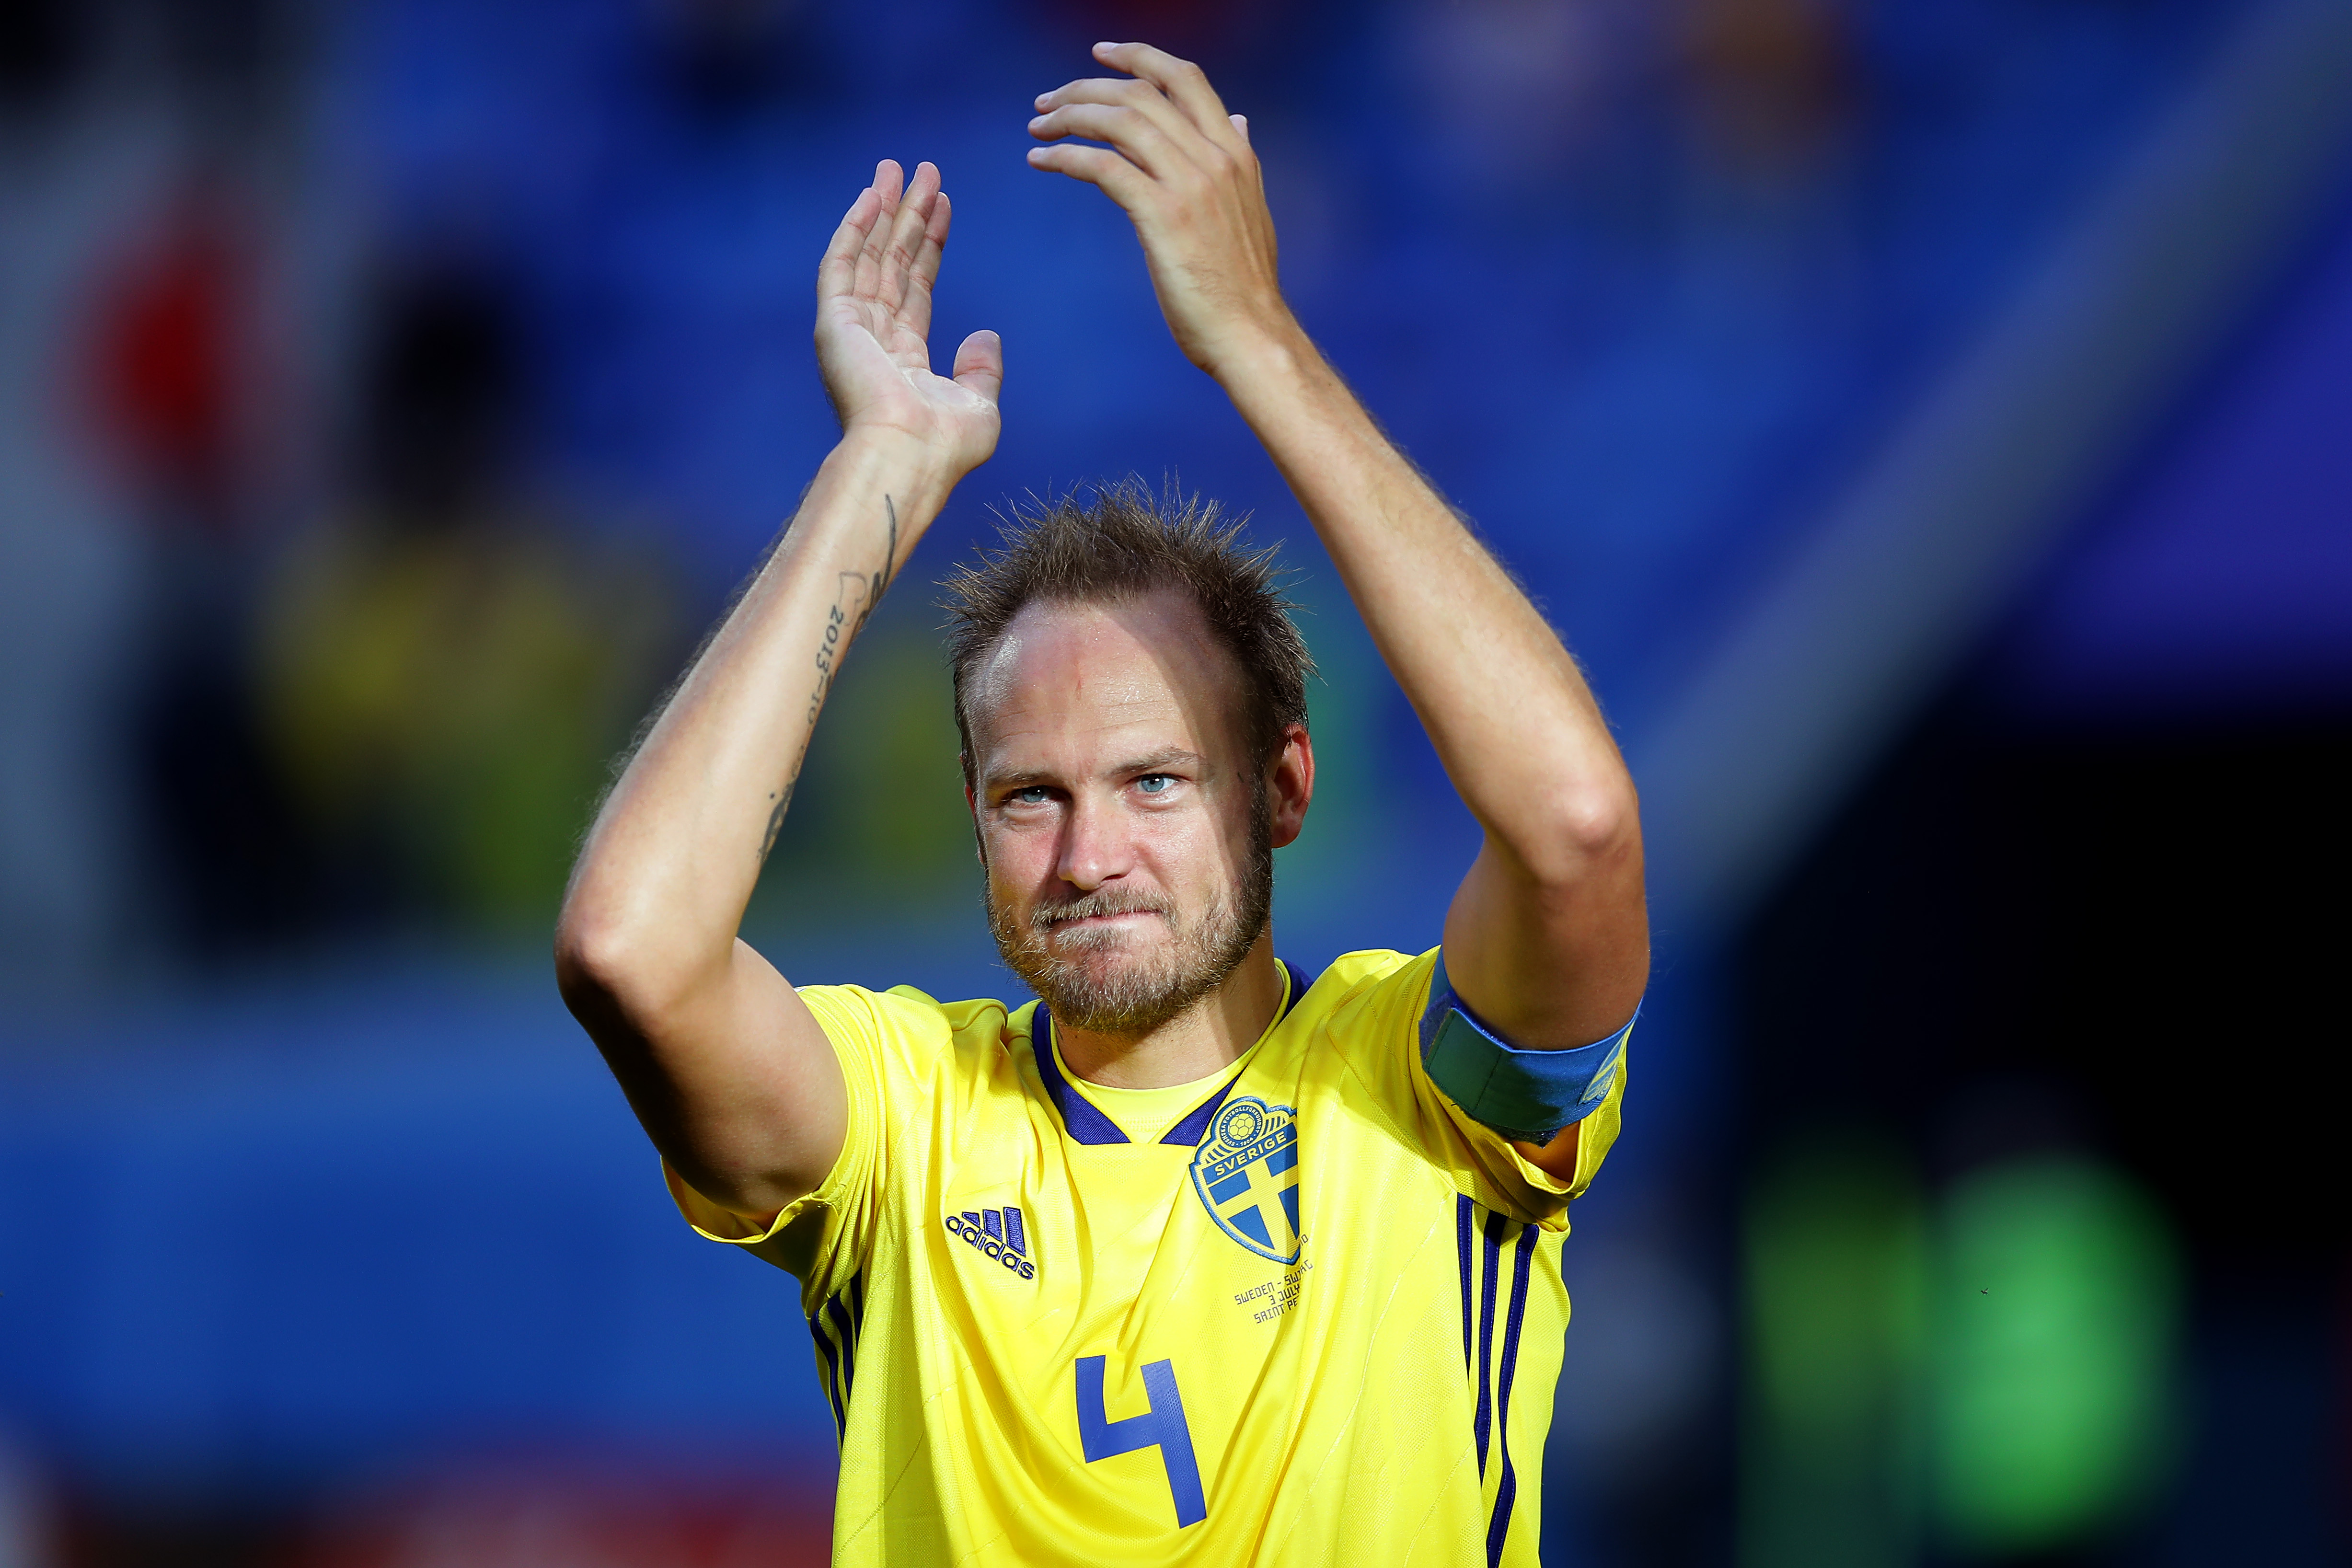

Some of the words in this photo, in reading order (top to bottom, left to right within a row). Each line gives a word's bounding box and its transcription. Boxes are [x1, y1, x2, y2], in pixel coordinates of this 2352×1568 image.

[1240, 1137, 1254, 1146] 1904
[1214, 1131, 1287, 1176] SVERIGE
[945, 1216, 1035, 1280] adidas
[1234, 1282, 1275, 1305] SWEDEN
[1268, 1295, 1276, 1305] 3
[1278, 1283, 1300, 1301] JULY
[1254, 1304, 1284, 1324] SAINT
[1075, 1354, 1207, 1529] 4
